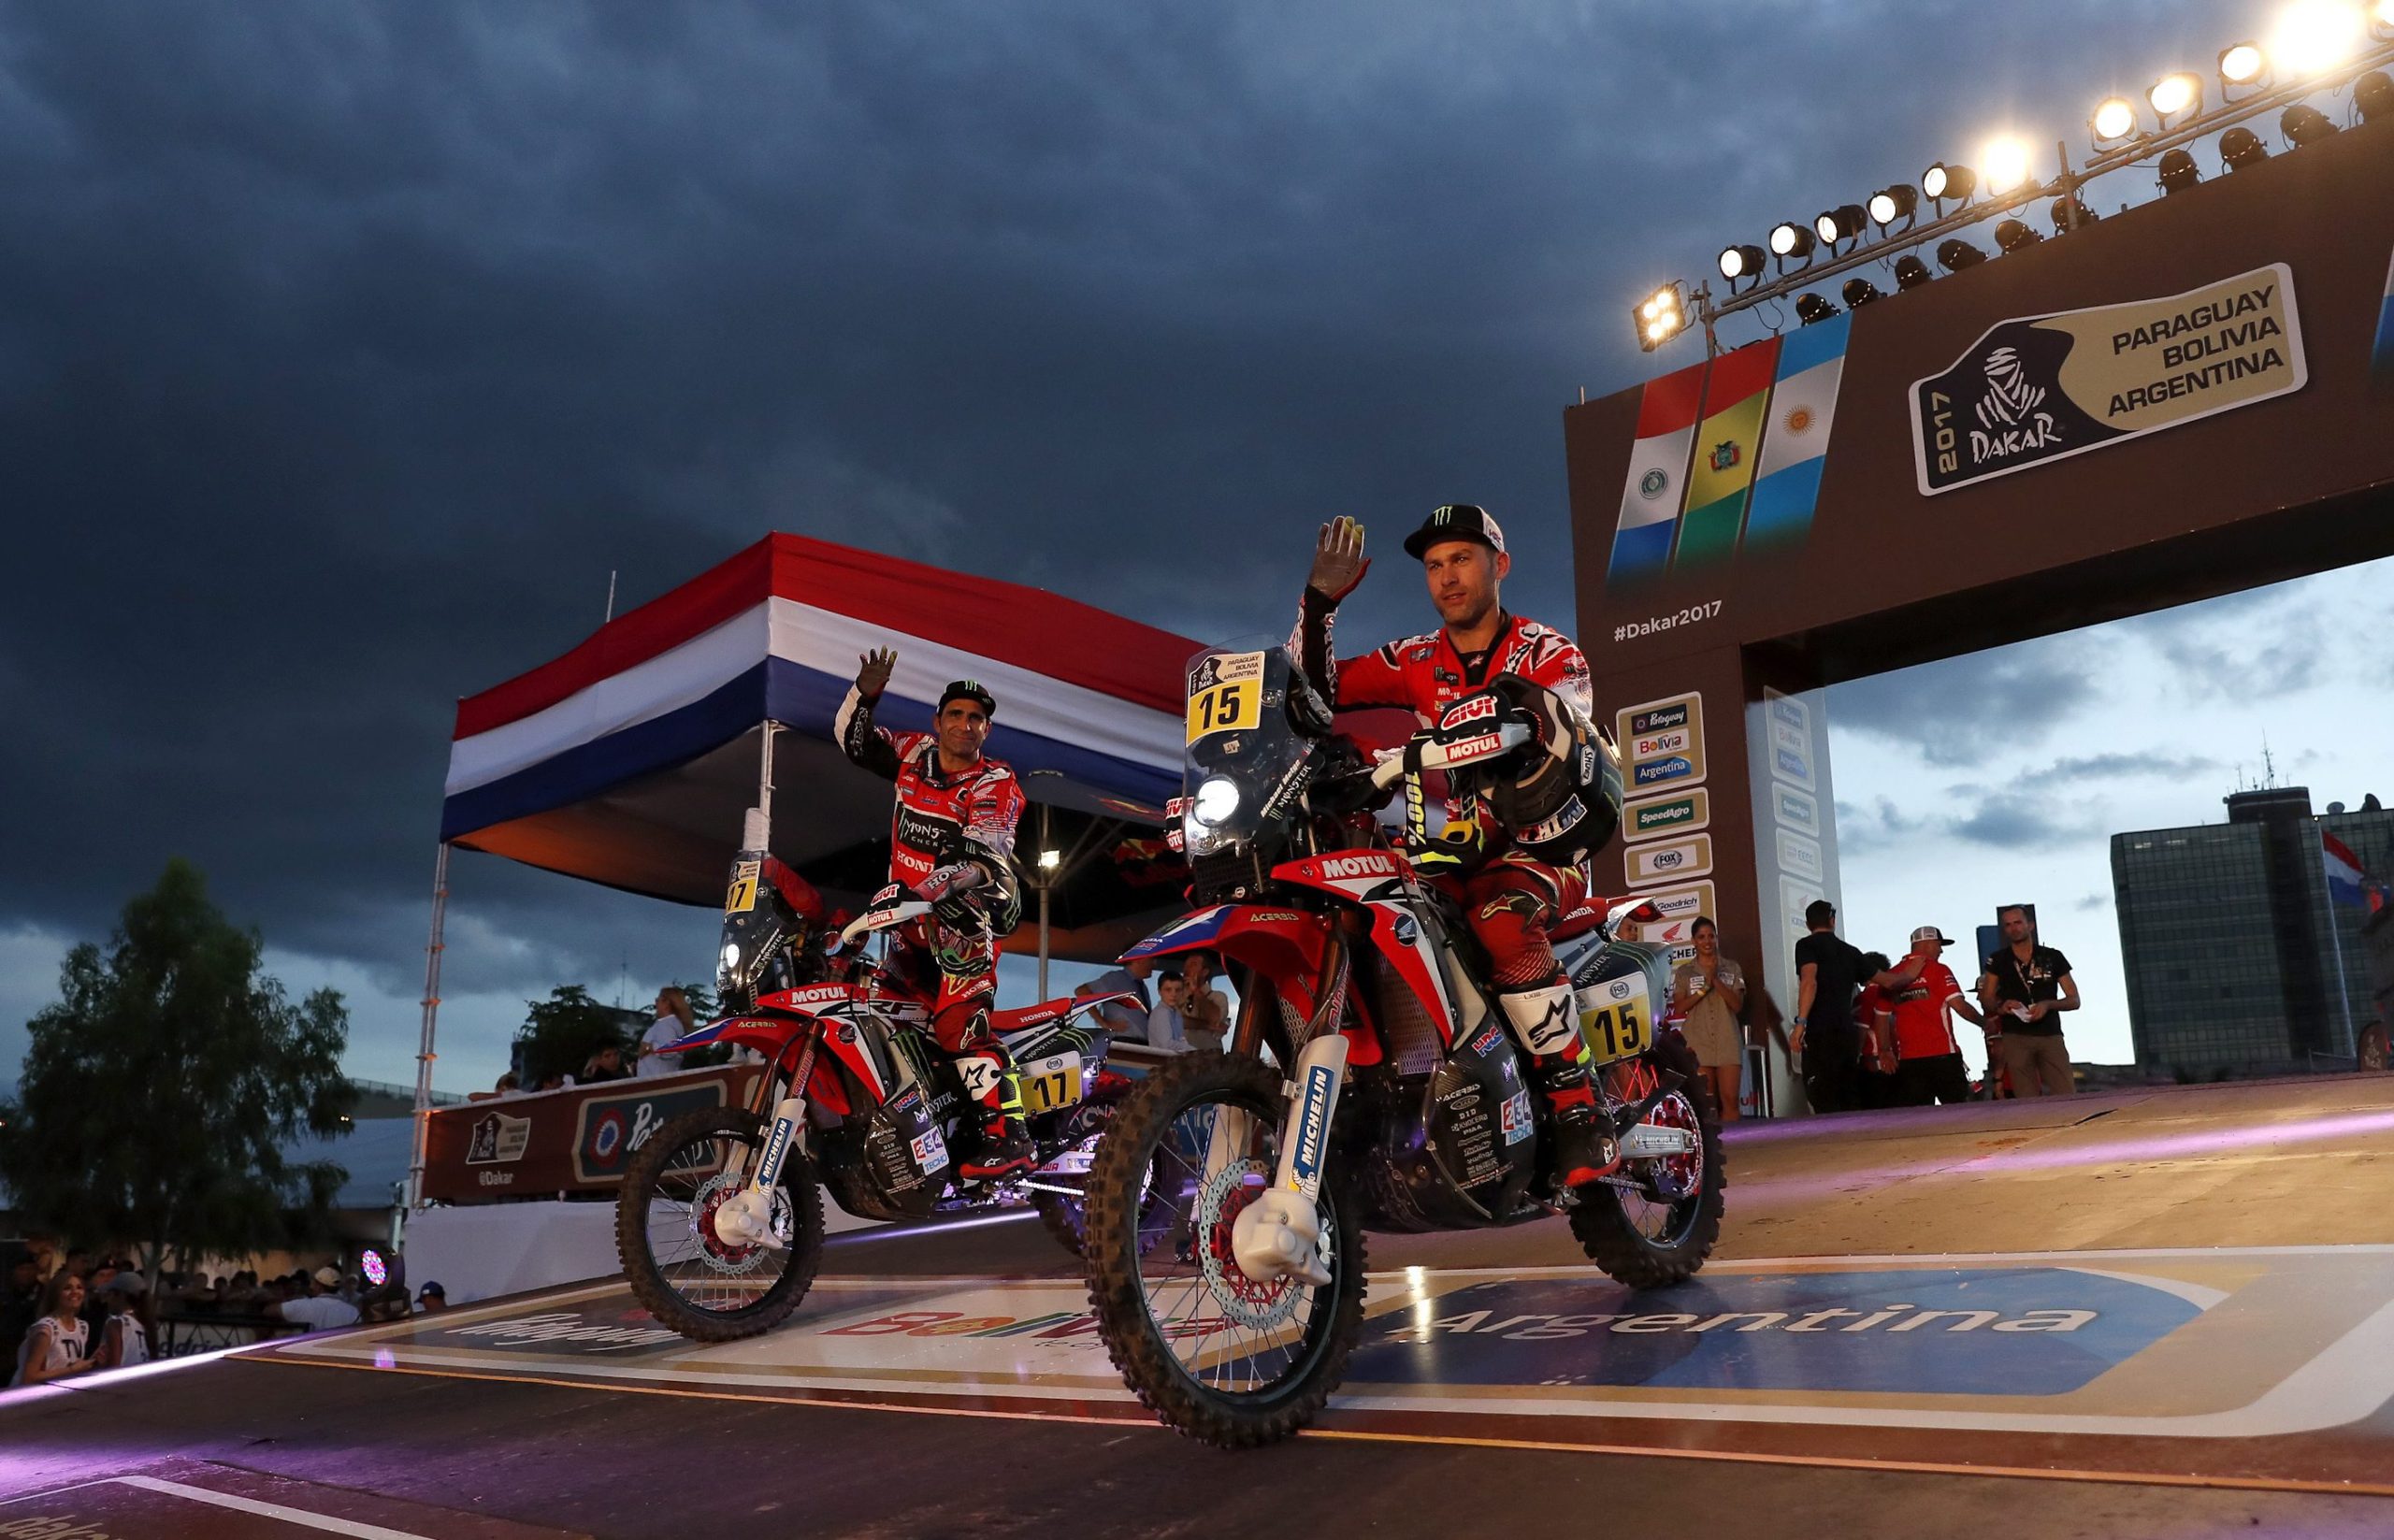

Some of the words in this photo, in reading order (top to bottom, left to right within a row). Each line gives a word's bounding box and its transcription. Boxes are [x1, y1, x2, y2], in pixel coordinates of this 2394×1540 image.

[2113, 285, 2274, 354] PARAGUAY
[2163, 316, 2281, 368] BOLIVIA
[2108, 348, 2284, 417] ARGENTINA
[1932, 391, 1958, 474] 2017
[1970, 412, 2062, 464] DAKAR
[1613, 601, 1723, 642] #Dakar2017
[1228, 655, 1260, 666] PARAGUAY
[1235, 662, 1259, 671] BOLIVIA
[1223, 670, 1258, 681] ARGENTINA
[1199, 685, 1241, 730] 15
[1443, 697, 1498, 727] GIVI
[1650, 711, 1684, 727] Paraguay
[1449, 736, 1500, 760] MOTUL
[1639, 735, 1682, 754] Bolivia
[1639, 760, 1686, 779] Argentina
[1277, 765, 1313, 808] MONSTER
[1405, 771, 1427, 845] 100%
[1640, 806, 1690, 824] SpeedAgro
[904, 817, 948, 840] MONS
[1168, 833, 1183, 848] OTU
[911, 836, 939, 847] ENER
[897, 850, 934, 874] HON
[1321, 855, 1396, 879] MOTUL
[1658, 853, 1676, 865] FOX
[728, 883, 747, 911] 17
[869, 913, 892, 926] MOTUL
[1250, 913, 1299, 922] ACERBIS
[1564, 905, 1595, 921] ONDA
[1576, 952, 1610, 986] MONSTER
[791, 986, 847, 1003] MOTUL
[1019, 1010, 1056, 1023] HONDA
[1594, 1002, 1640, 1056] 15
[1033, 1072, 1067, 1108] 17
[1301, 1069, 1327, 1166] MICHELIN
[763, 1120, 787, 1178] MICHELIN
[1386, 1303, 2099, 1341] Argentina
[62, 1339, 83, 1359] TV
